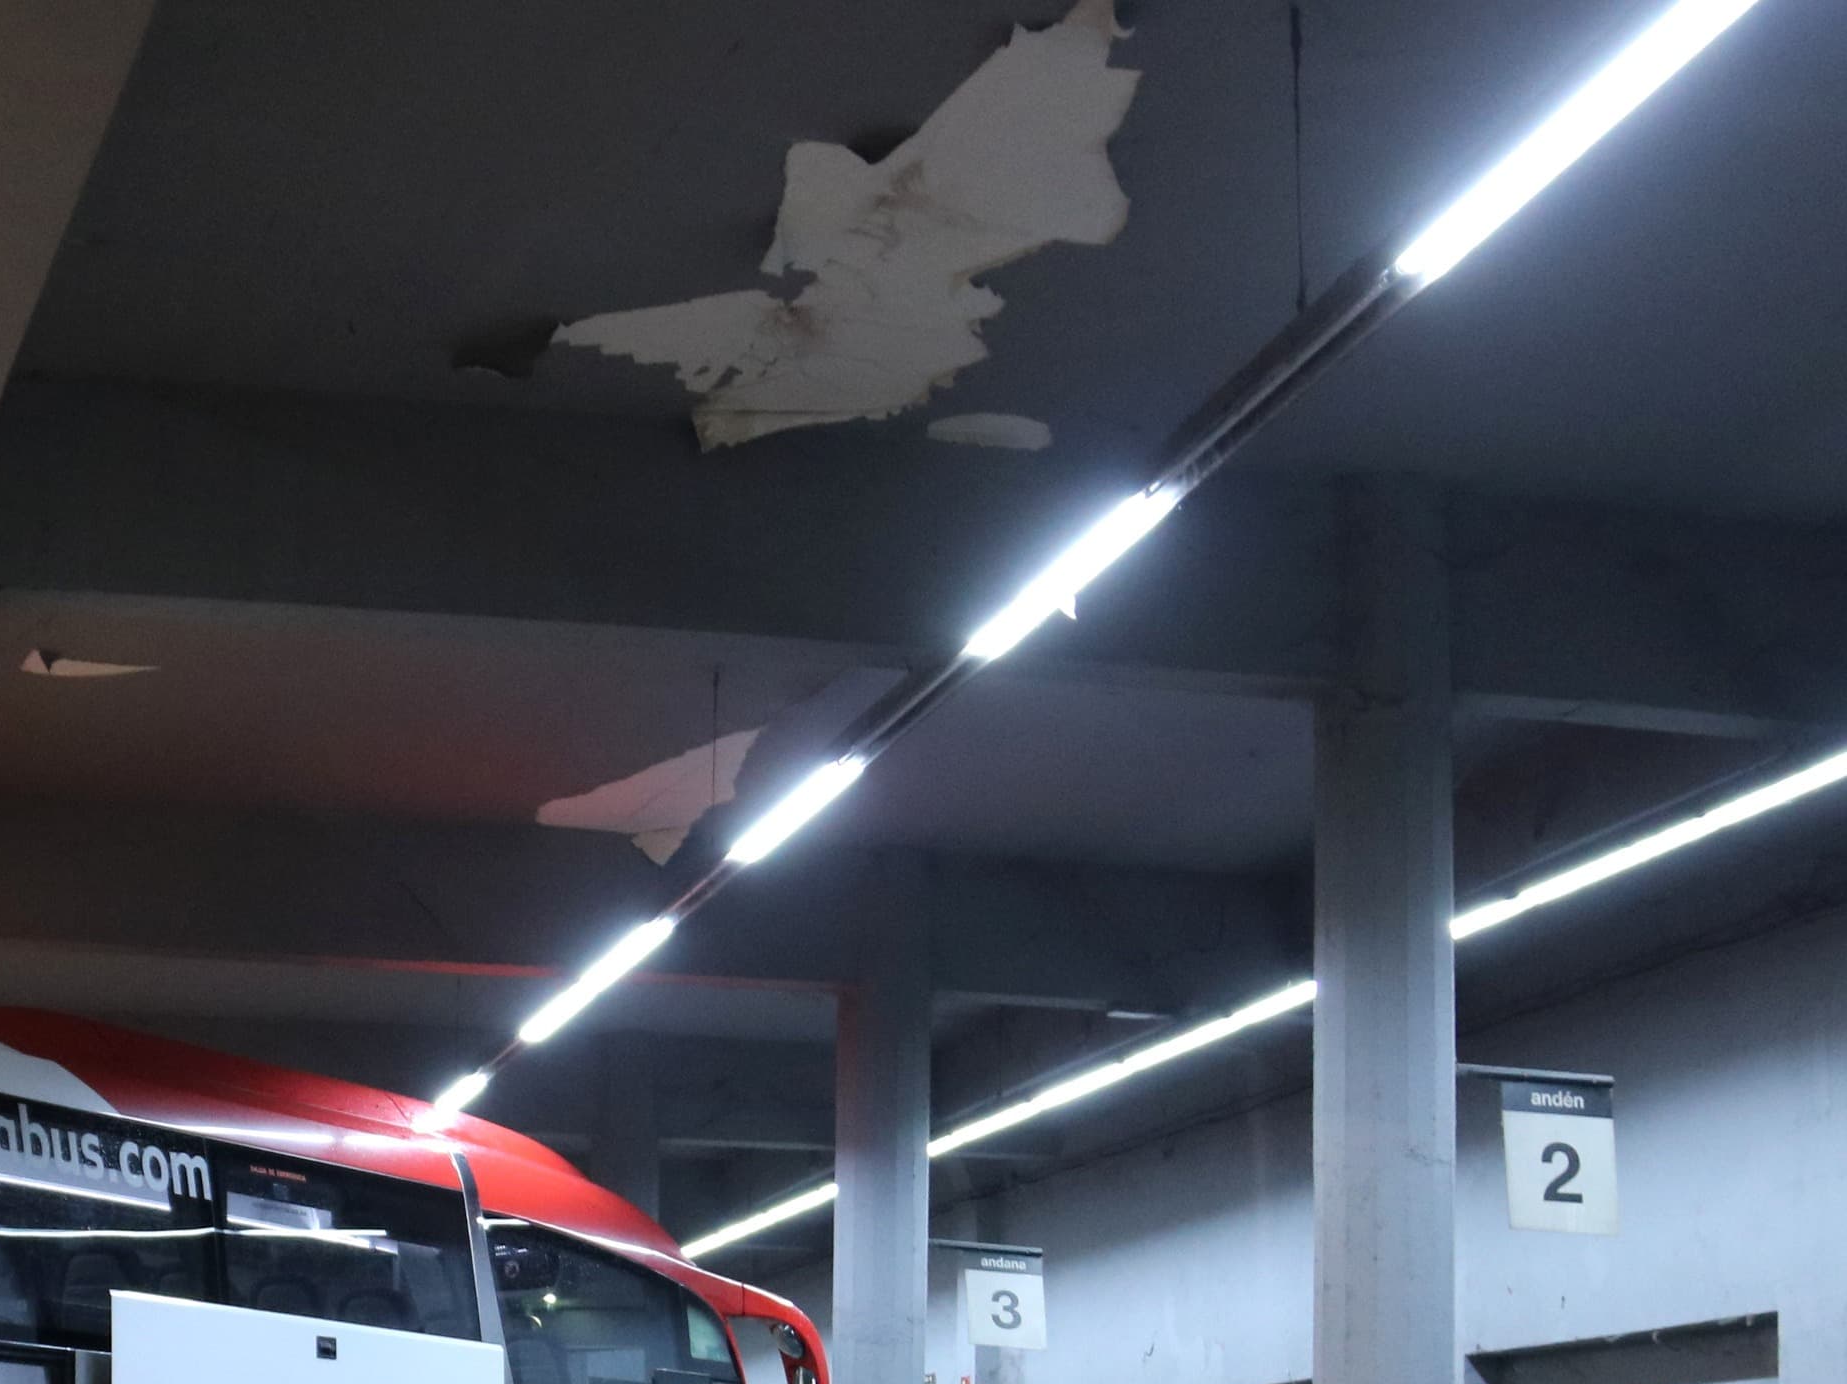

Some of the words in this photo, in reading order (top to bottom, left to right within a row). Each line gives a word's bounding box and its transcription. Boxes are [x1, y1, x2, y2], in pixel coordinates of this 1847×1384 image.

[1531, 1090, 1585, 1109] andén
[1541, 1141, 1583, 1204] 2
[981, 1256, 1027, 1271] andana
[991, 1289, 1022, 1330] 3
